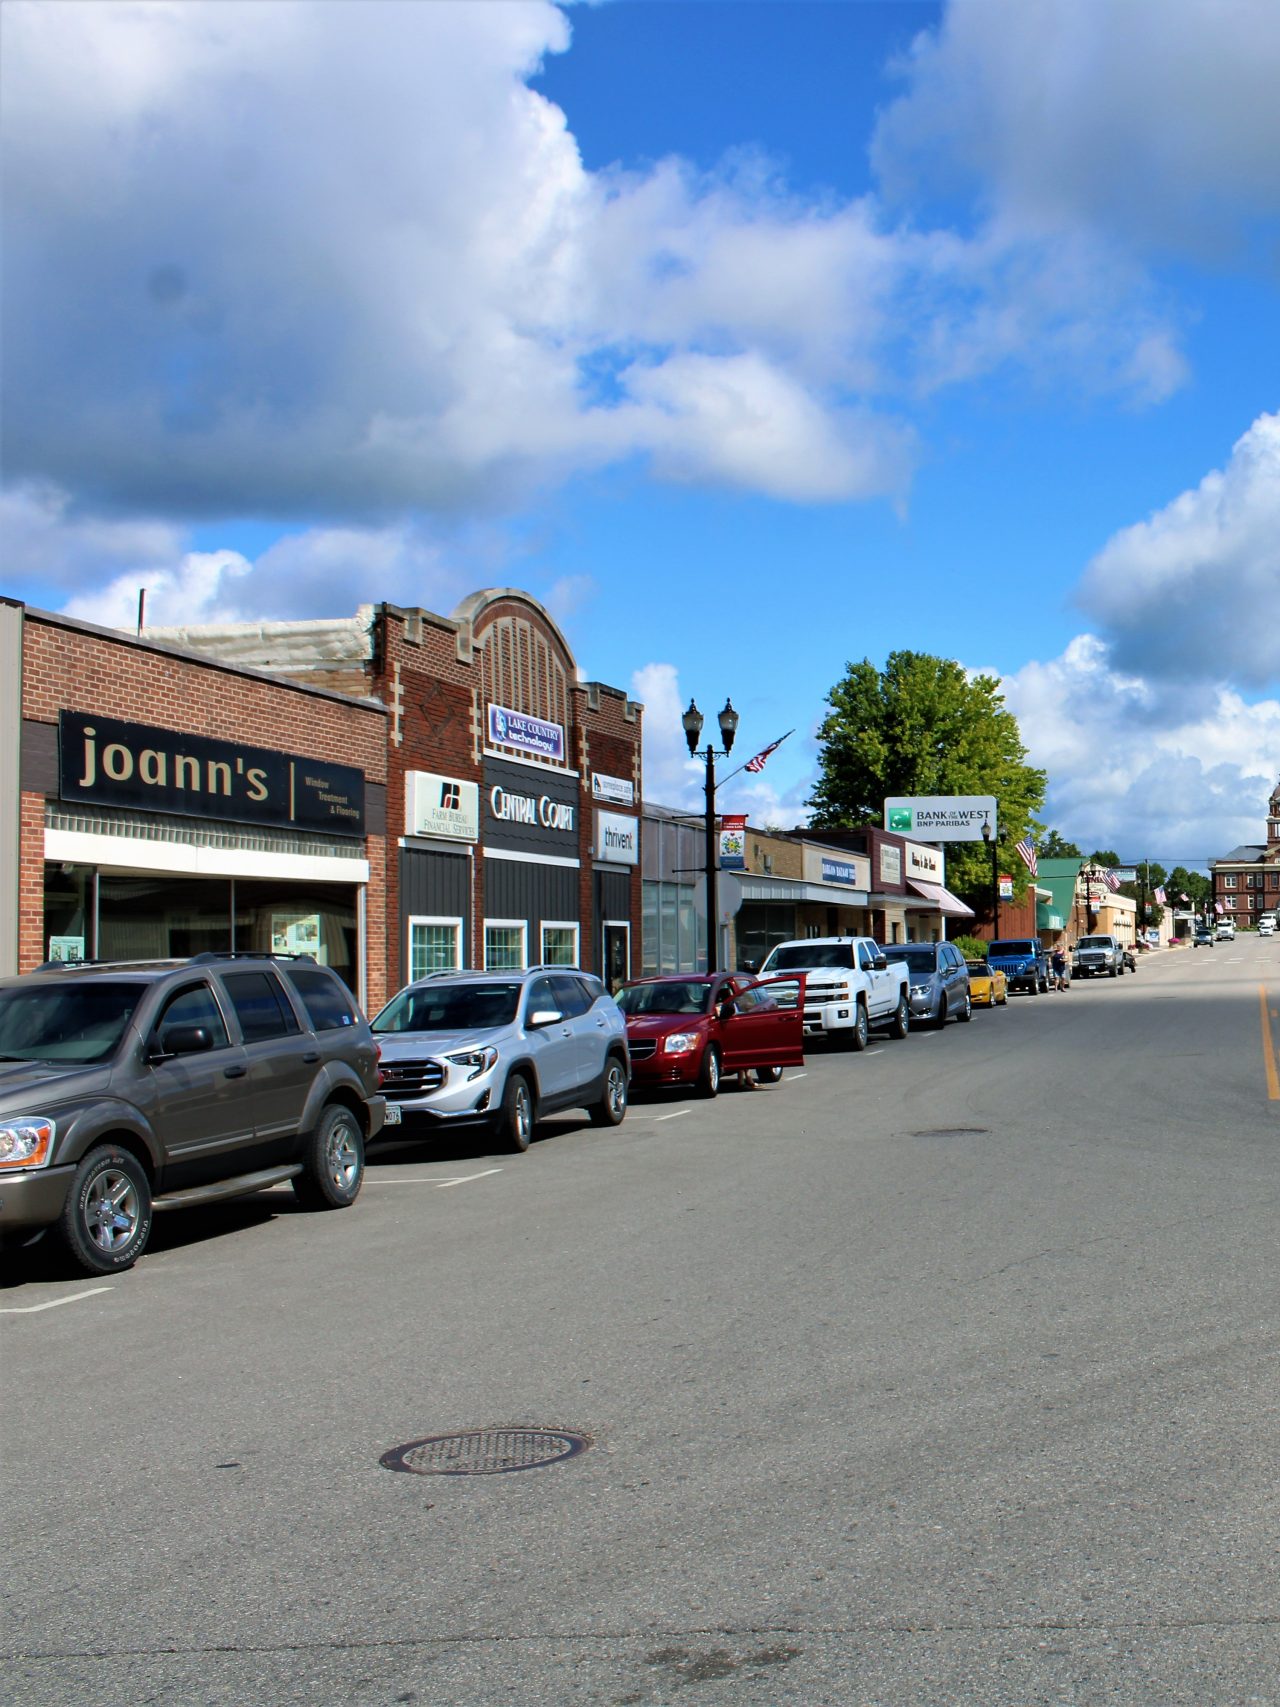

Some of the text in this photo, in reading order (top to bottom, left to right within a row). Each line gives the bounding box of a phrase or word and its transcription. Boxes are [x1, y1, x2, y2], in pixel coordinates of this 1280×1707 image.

[508, 716, 559, 740] LAKE COUNTRY
[508, 730, 552, 752] technology
[79, 727, 269, 801] joann's
[305, 776, 329, 789] Window
[319, 791, 348, 804] Treatment
[336, 806, 360, 819] Flooring
[432, 808, 448, 820] FARM
[491, 786, 574, 831] CENTRAL COURT
[917, 811, 947, 820] BANK
[958, 810, 990, 819] WEST
[424, 819, 452, 833] FINANCIAL
[605, 826, 632, 850] thrivent
